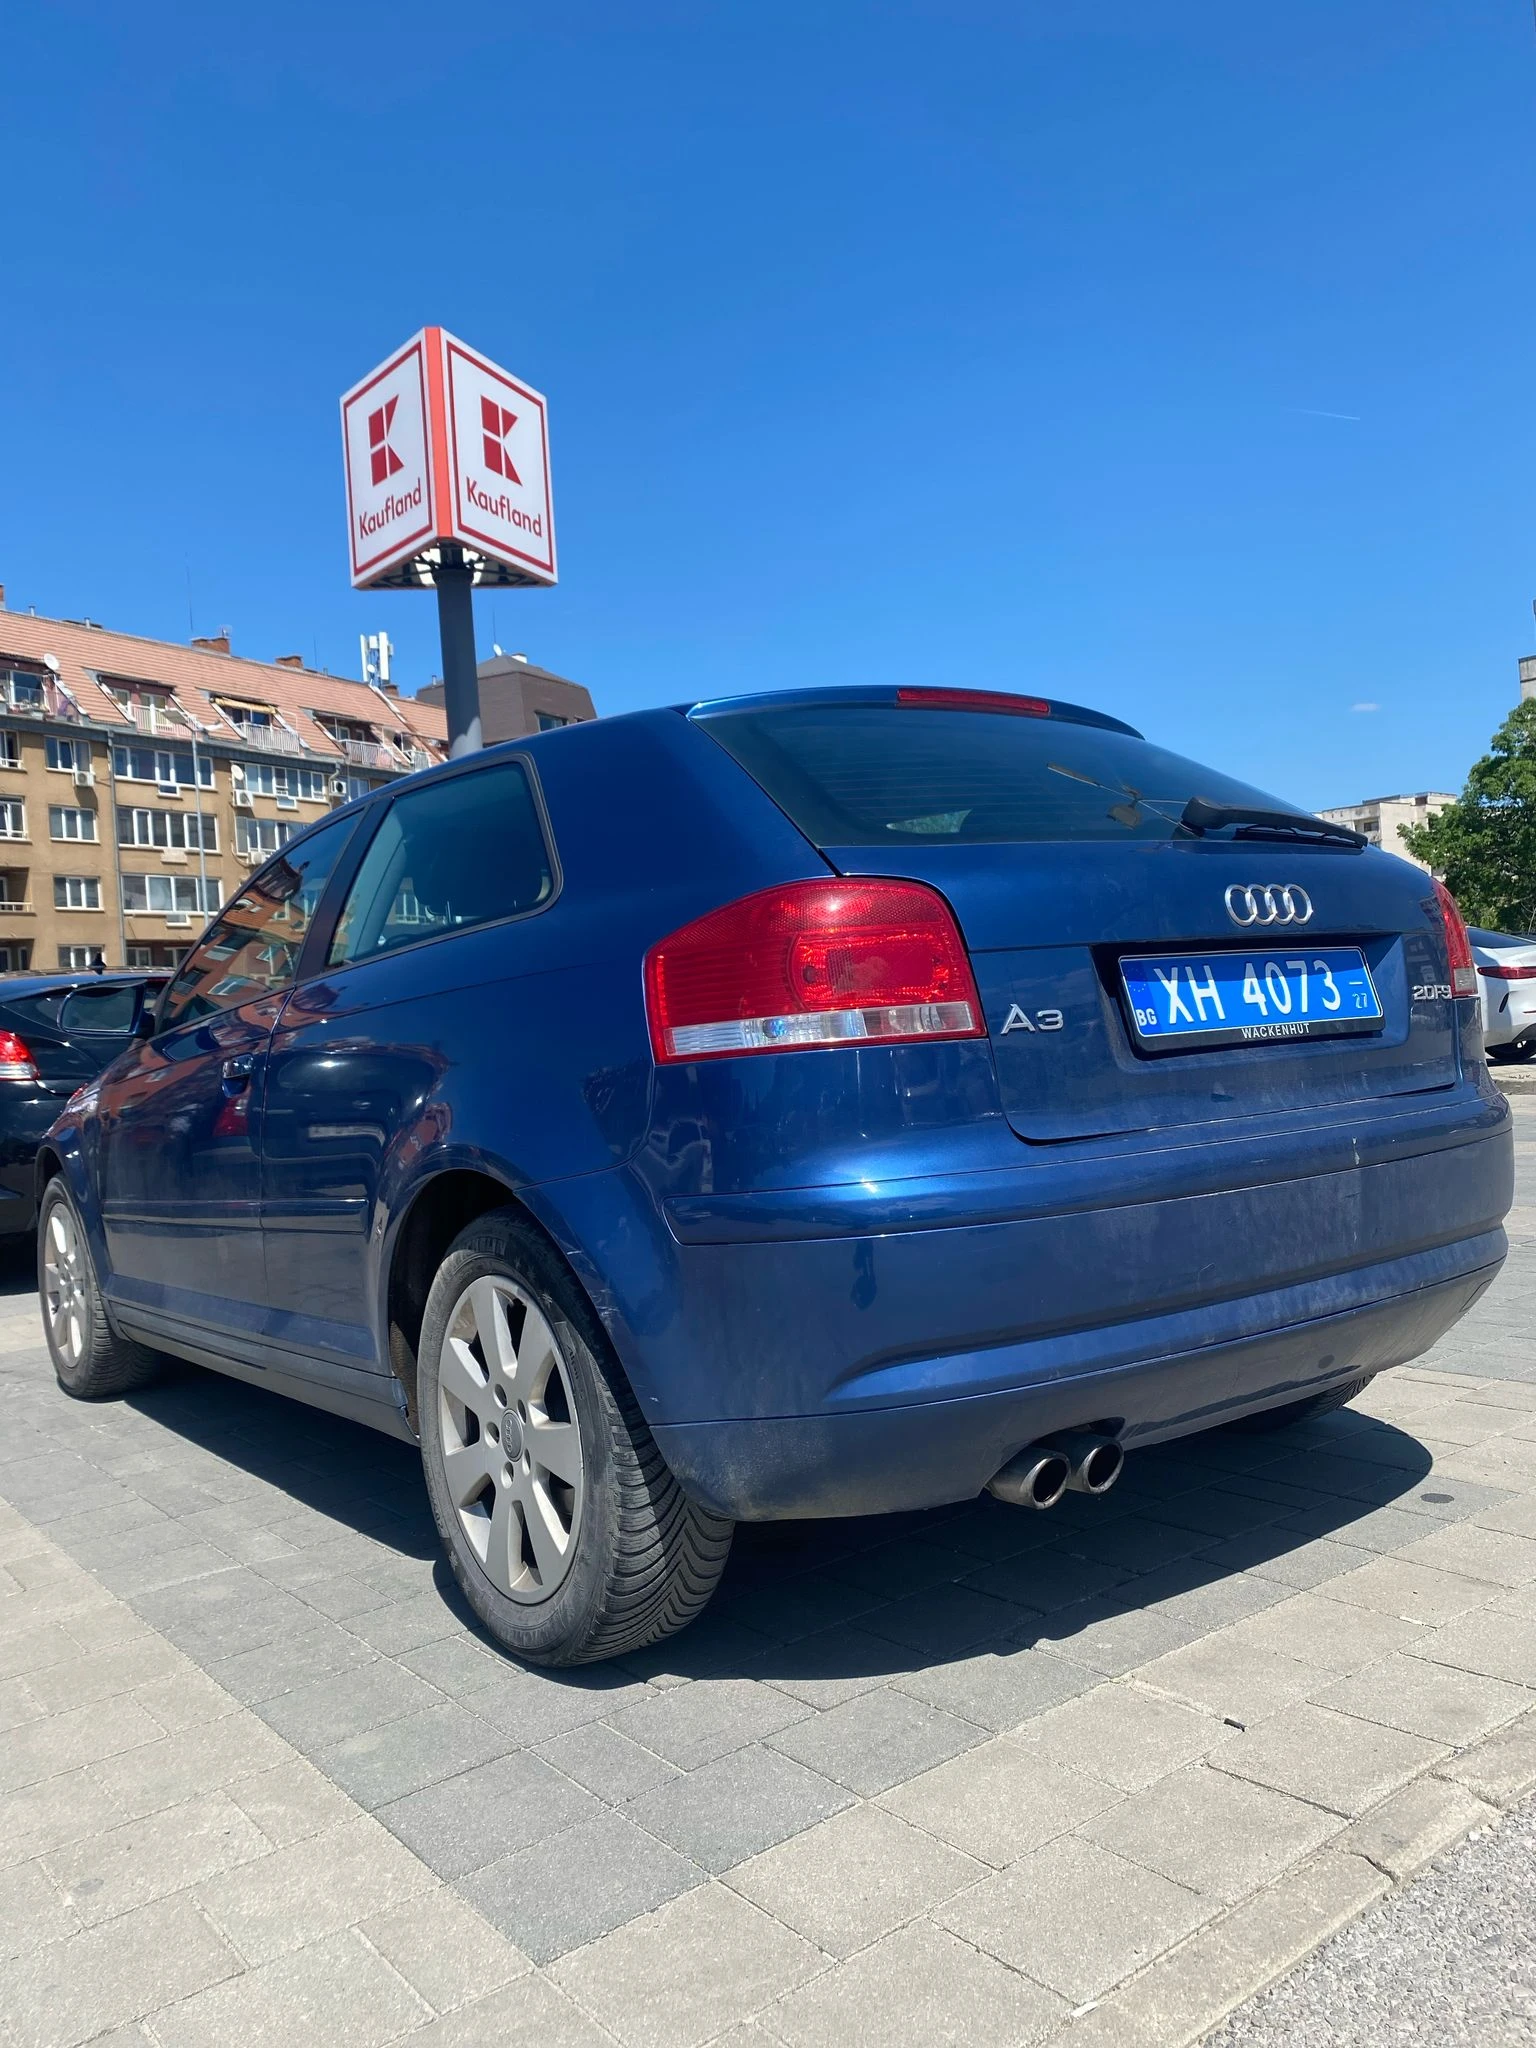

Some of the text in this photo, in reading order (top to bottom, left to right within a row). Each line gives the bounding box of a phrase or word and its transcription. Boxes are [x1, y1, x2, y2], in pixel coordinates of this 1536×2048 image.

[359, 477, 422, 540] Kaufland
[466, 476, 542, 538] Kaufland
[1154, 960, 1341, 1025] XH 4073
[1352, 992, 1368, 1008] 27
[1000, 1003, 1064, 1035] A3
[1135, 1008, 1157, 1027] BG
[1242, 1023, 1310, 1039] WACKENHUT
